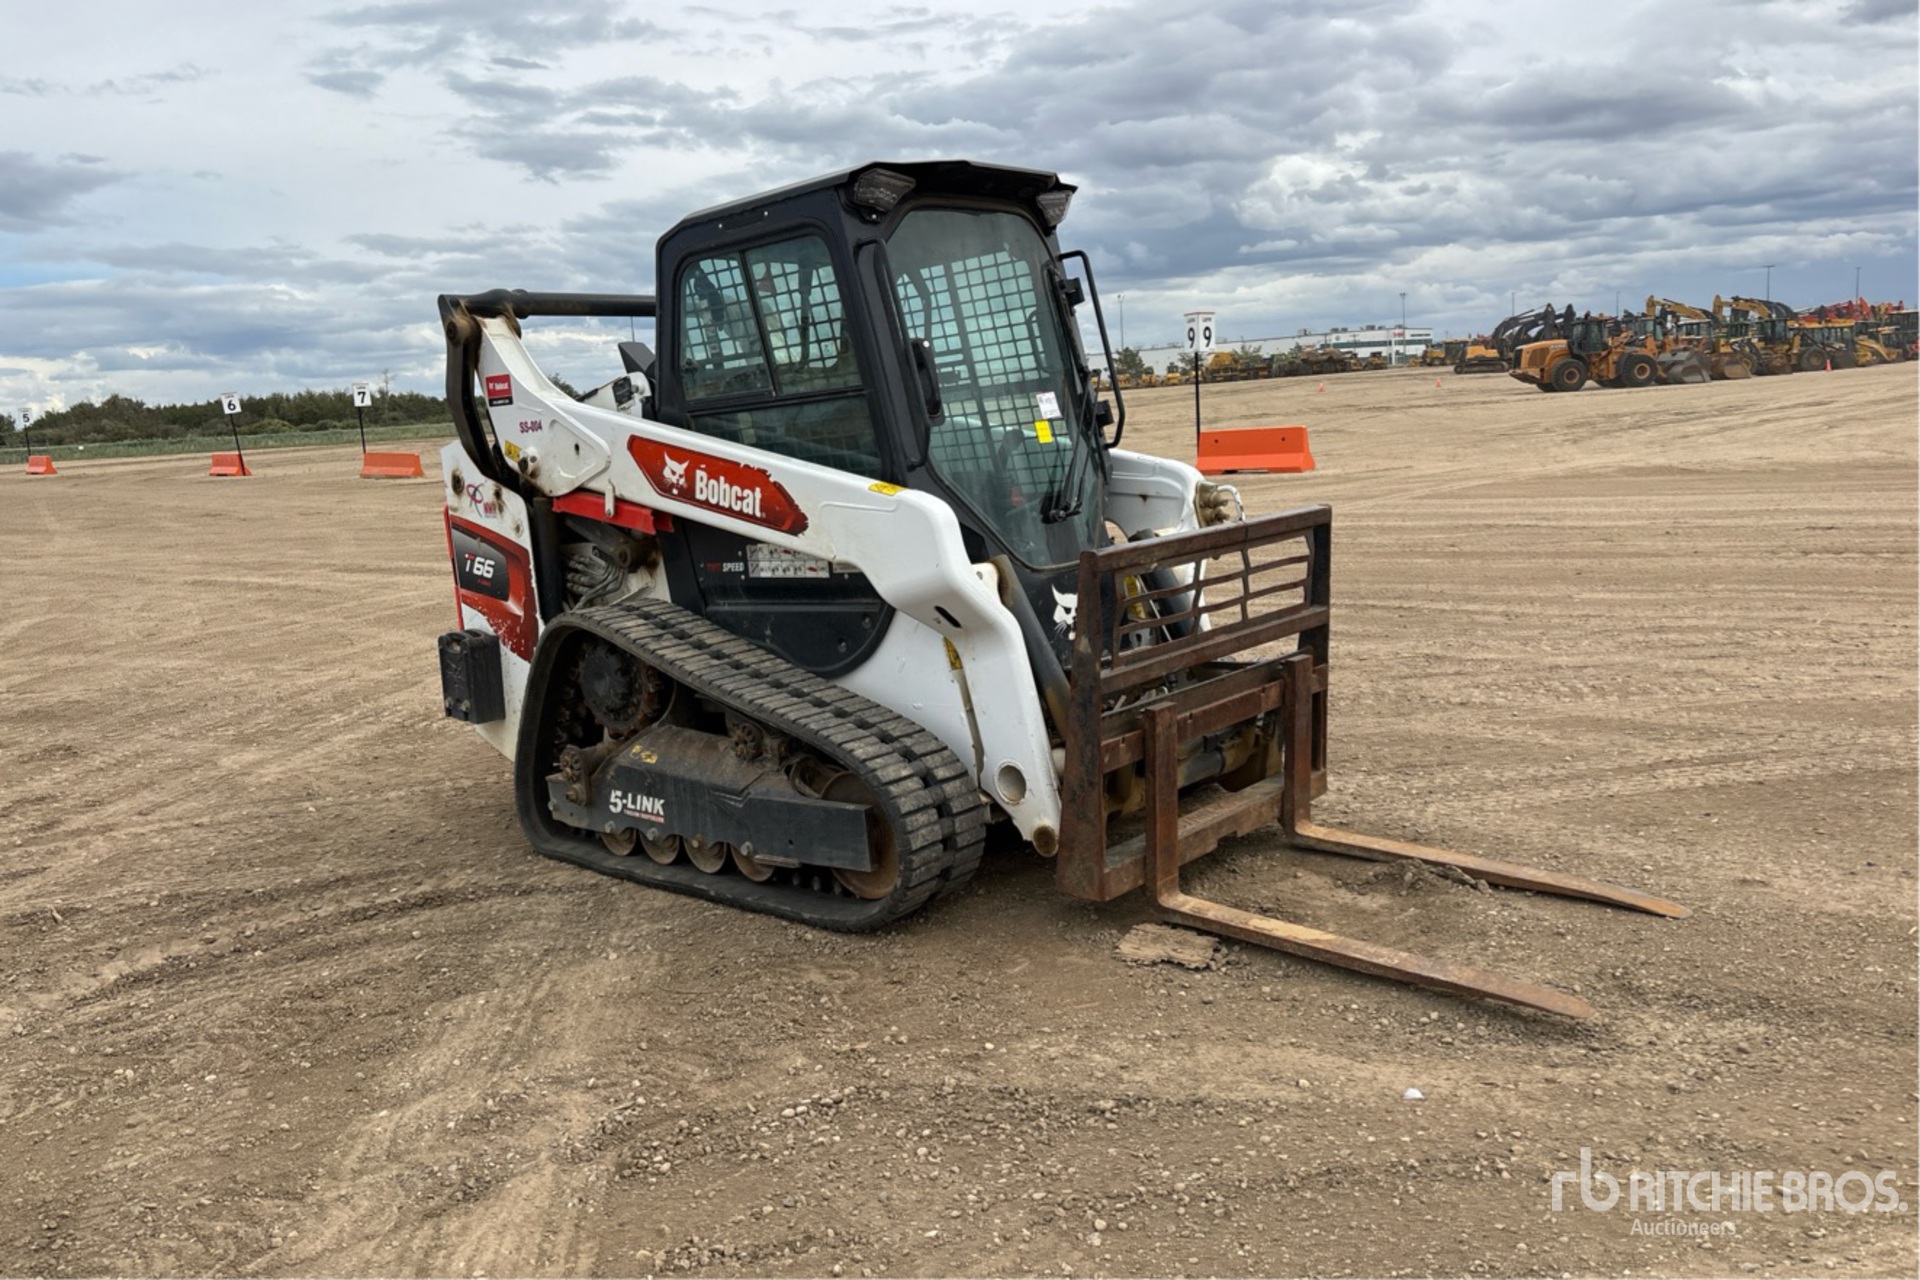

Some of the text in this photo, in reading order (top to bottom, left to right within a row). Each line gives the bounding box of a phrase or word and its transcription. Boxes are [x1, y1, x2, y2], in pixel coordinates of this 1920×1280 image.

[1187, 327, 1195, 349] 9
[1203, 326, 1212, 348] 9
[227, 399, 236, 411] 6
[357, 391, 366, 404] 7
[22, 413, 30, 423] 5
[695, 469, 762, 518] Bobcat
[722, 562, 745, 572] SPEED
[609, 789, 666, 816] 5-LINK
